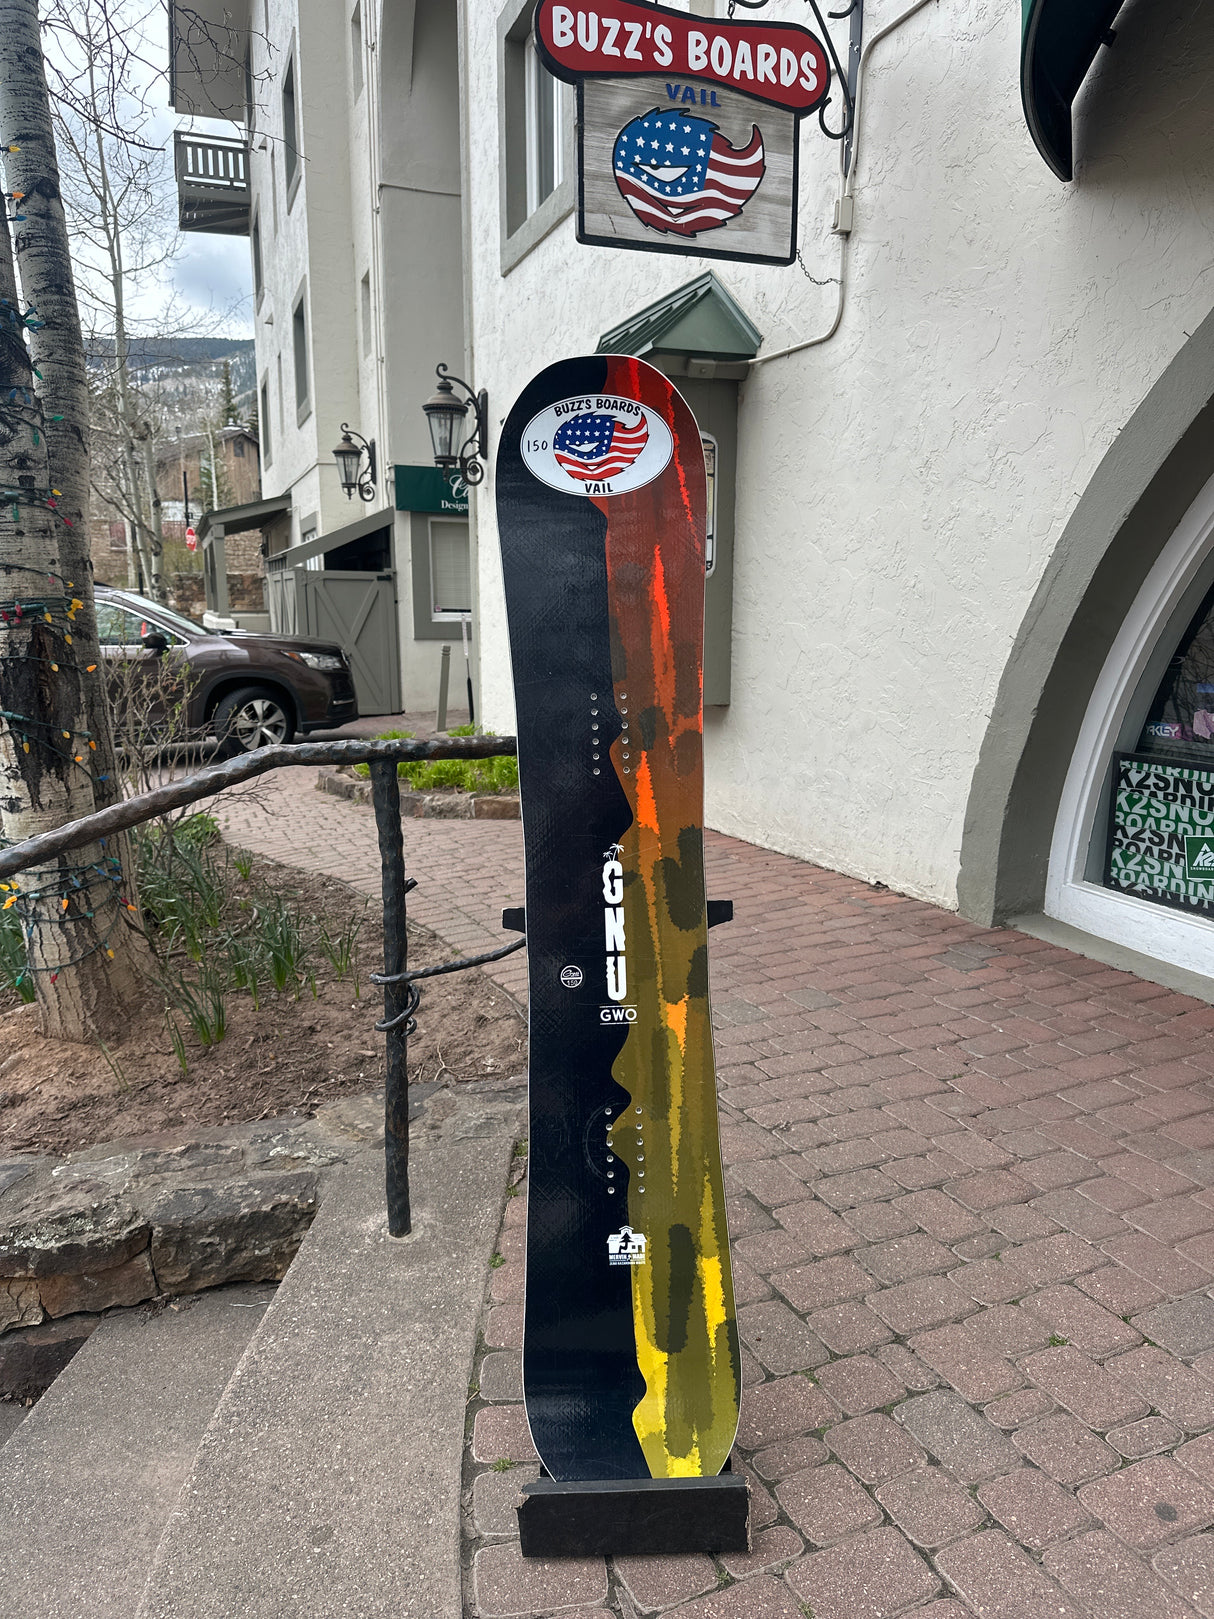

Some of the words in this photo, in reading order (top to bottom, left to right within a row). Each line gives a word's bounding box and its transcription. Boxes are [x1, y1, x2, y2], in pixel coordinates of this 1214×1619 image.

[552, 6, 673, 67] BUZZ'S
[688, 31, 817, 92] BOARDS
[666, 83, 721, 108] VAIL
[554, 399, 592, 417] BUZZ'S
[596, 398, 641, 417] BOARDS
[527, 440, 548, 452] 150
[585, 483, 613, 494] VAIL
[602, 860, 627, 1001] GNU
[600, 1008, 637, 1022] GWO
